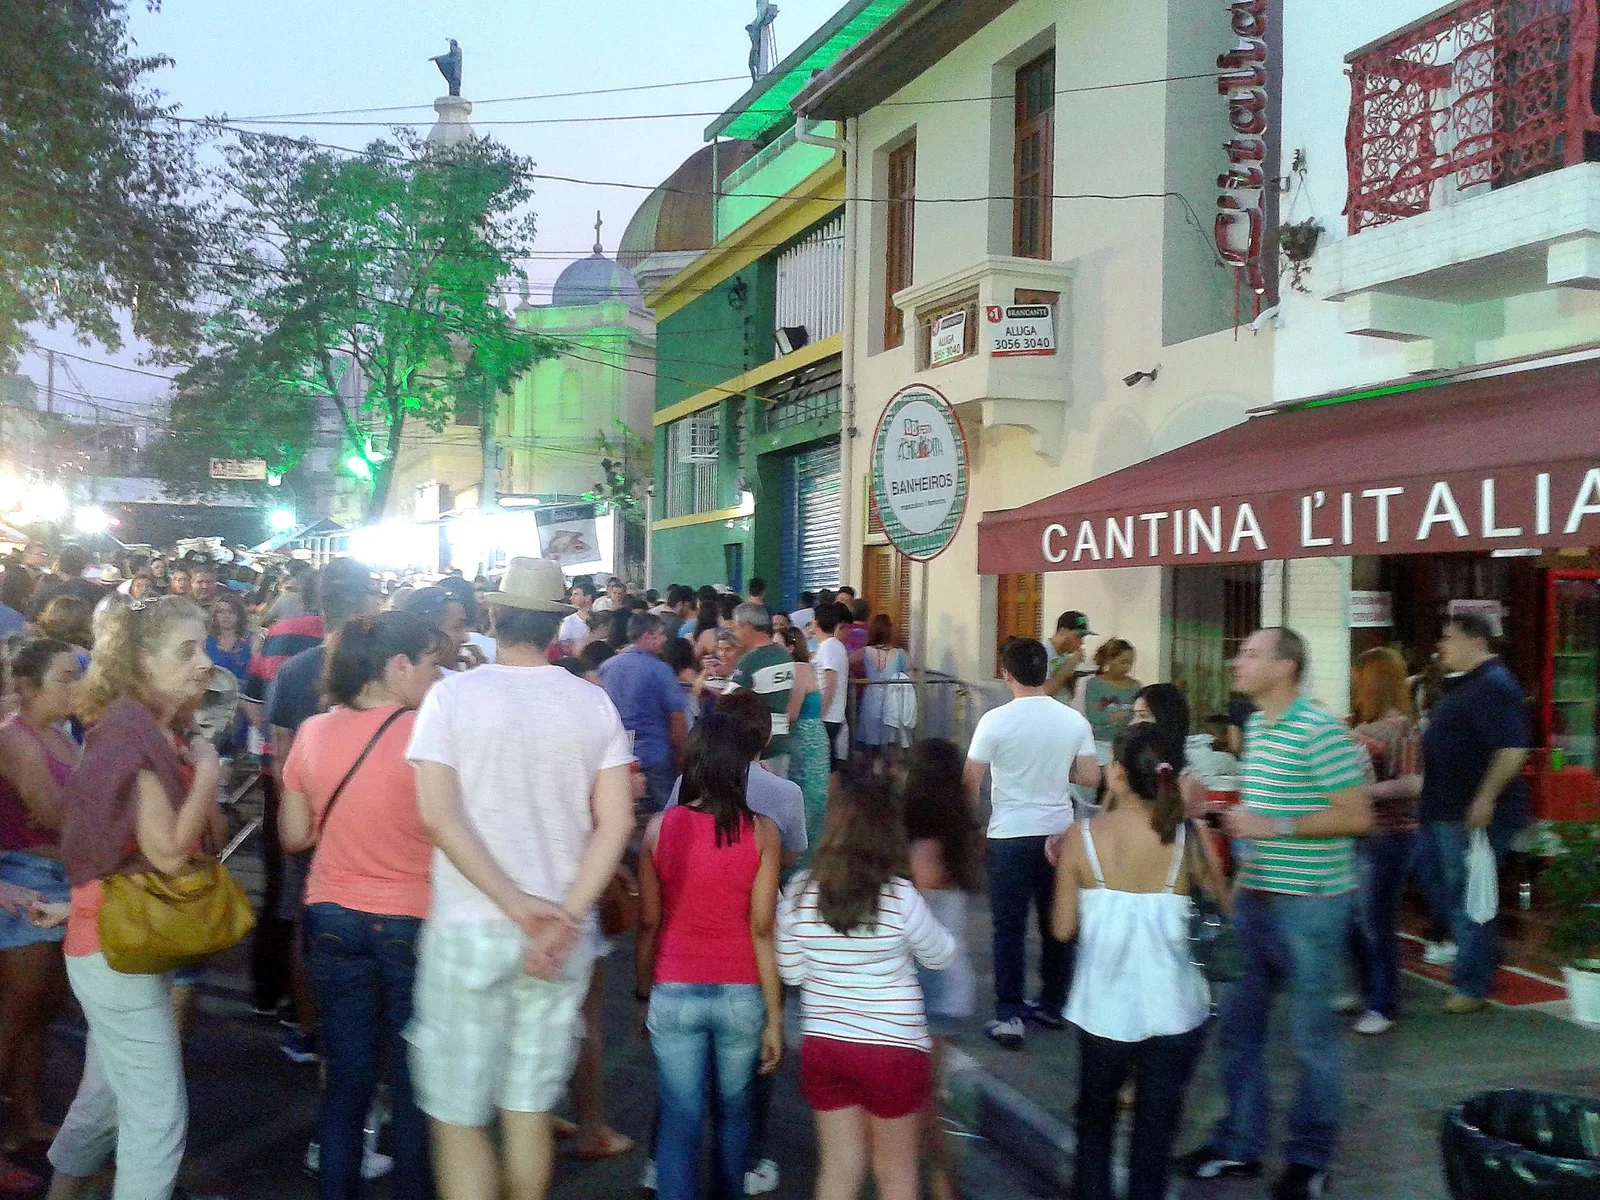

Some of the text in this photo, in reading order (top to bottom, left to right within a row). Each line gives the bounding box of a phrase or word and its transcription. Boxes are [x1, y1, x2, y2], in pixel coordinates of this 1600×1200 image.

[1005, 325, 1037, 337] ALUGA
[938, 334, 955, 347] ALUGA
[994, 337, 1050, 350] 3056 3040
[892, 473, 953, 496] BANHEIROS
[1041, 502, 1268, 564] CANTINA
